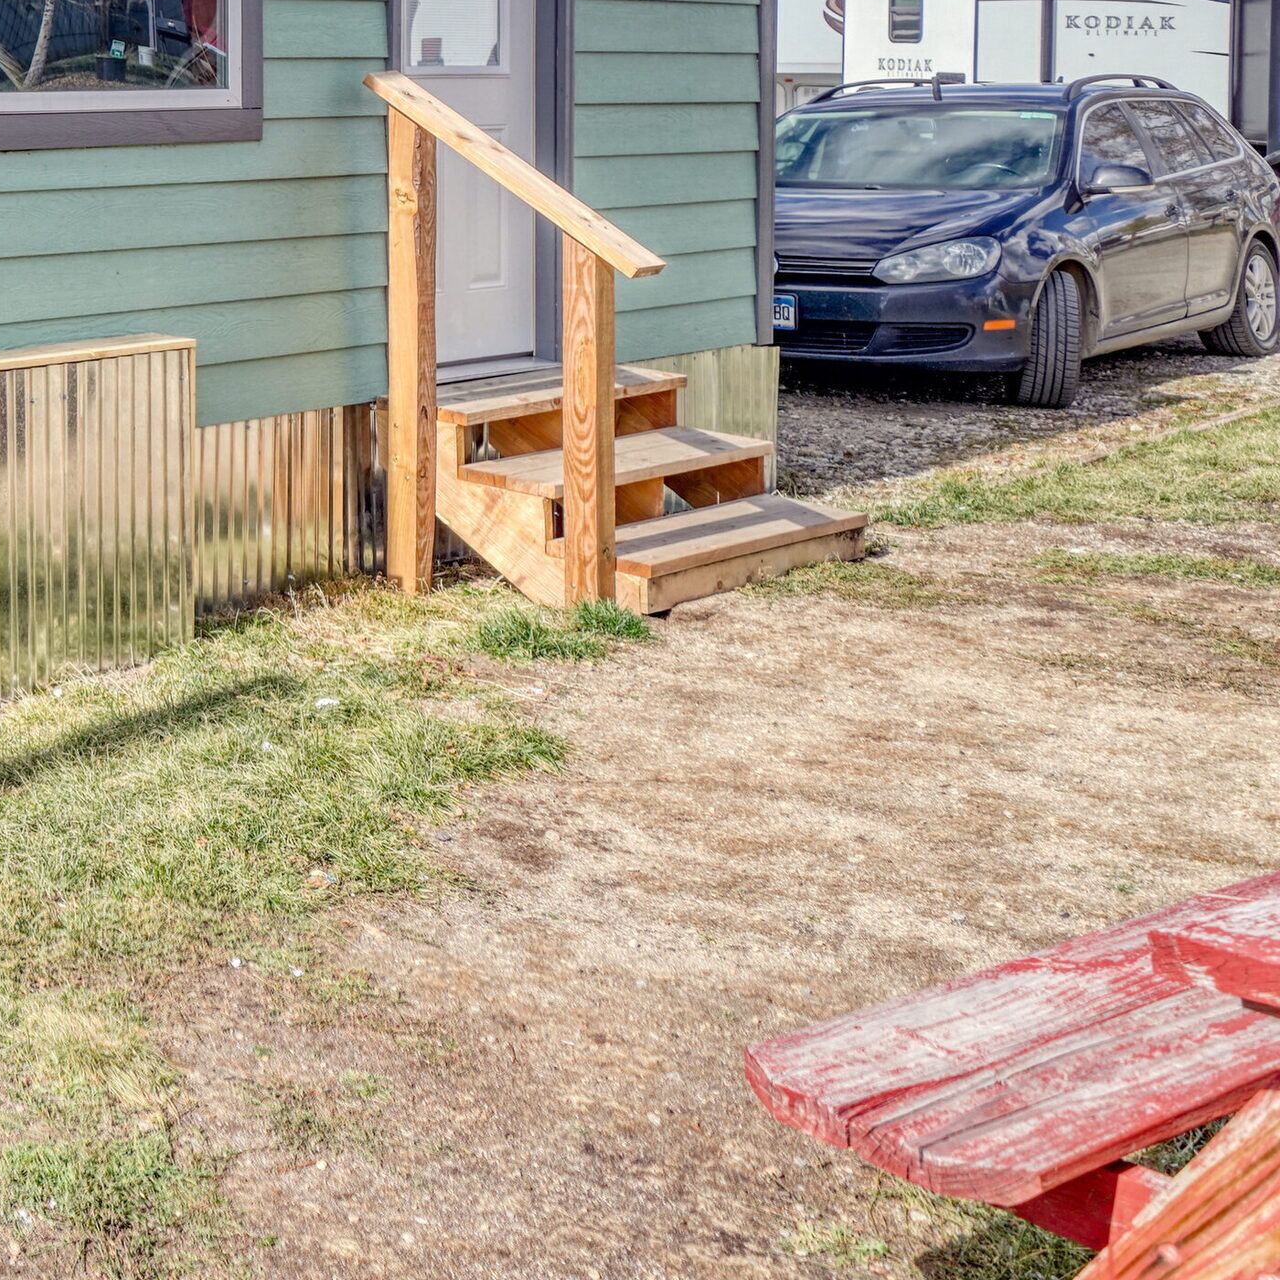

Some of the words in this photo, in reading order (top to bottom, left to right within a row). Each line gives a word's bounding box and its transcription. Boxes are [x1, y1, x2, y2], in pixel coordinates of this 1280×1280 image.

[1065, 15, 1176, 30] KODIAK
[1086, 29, 1158, 37] ULTIMATE
[878, 58, 932, 72] KODIAK
